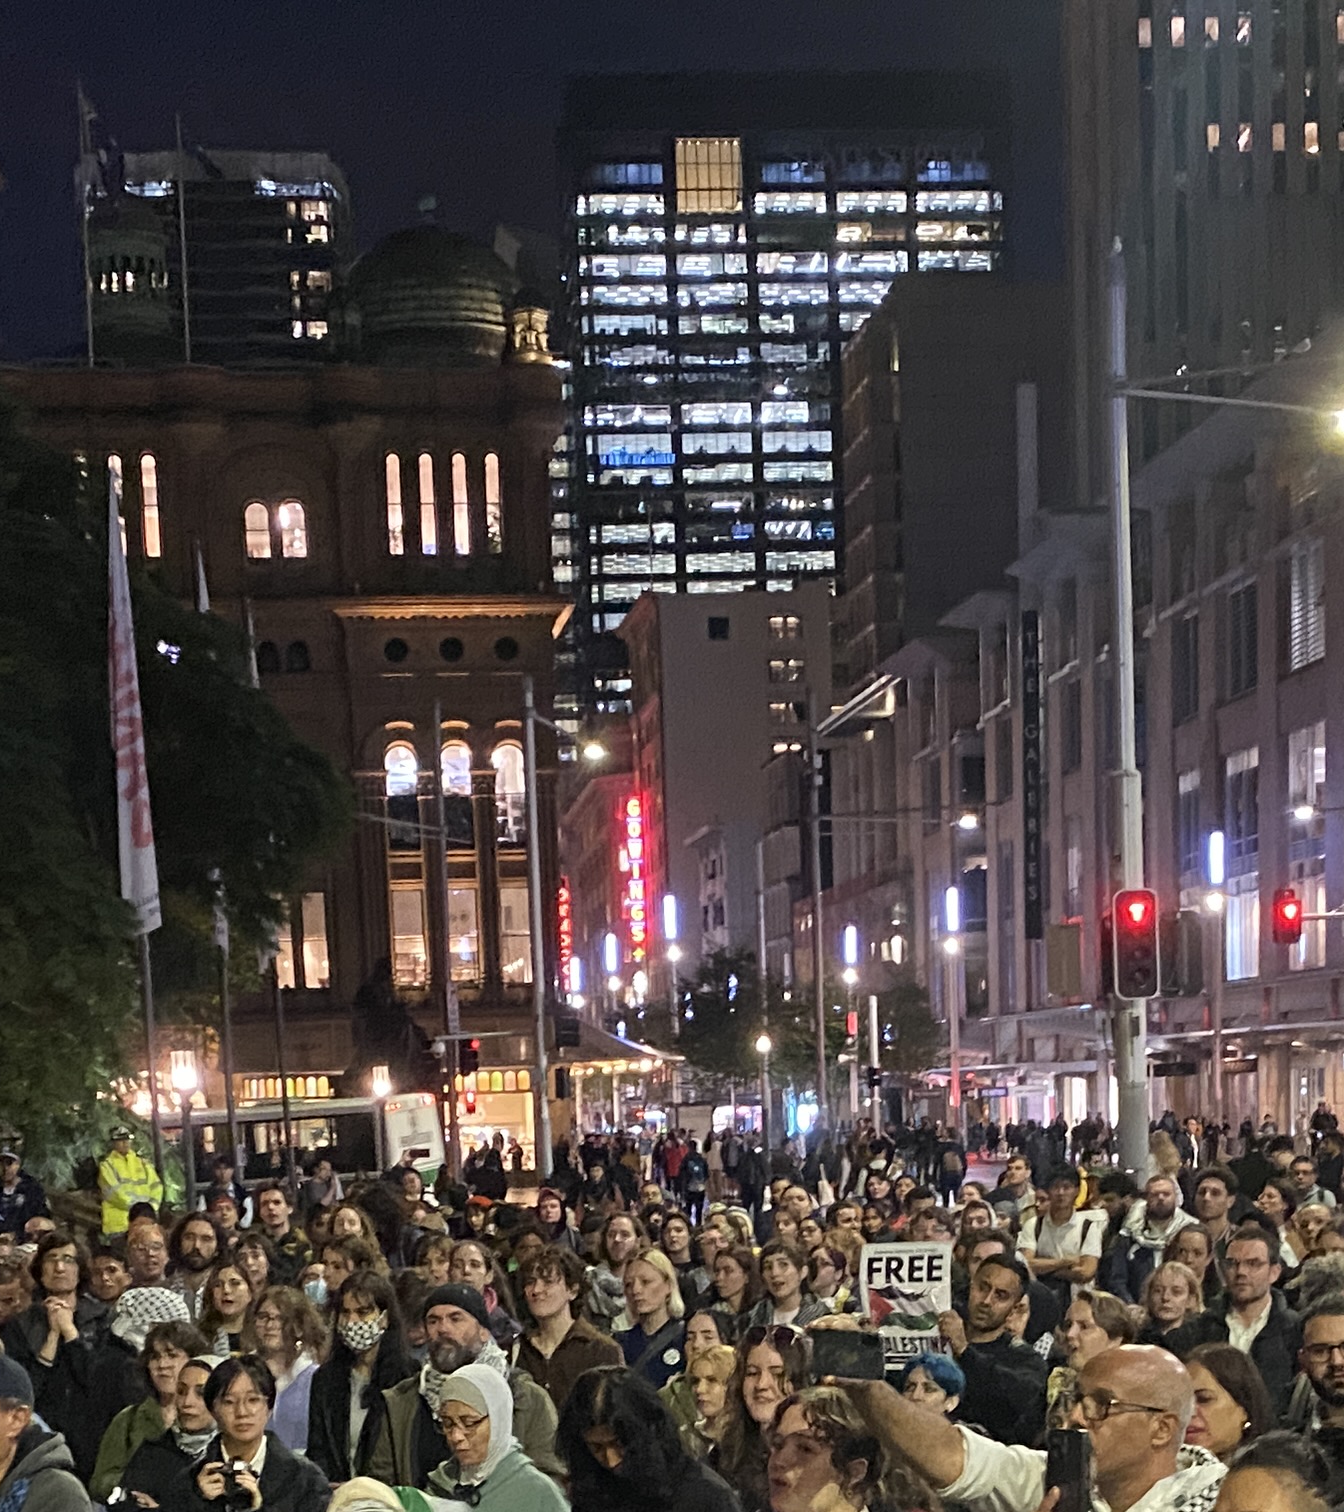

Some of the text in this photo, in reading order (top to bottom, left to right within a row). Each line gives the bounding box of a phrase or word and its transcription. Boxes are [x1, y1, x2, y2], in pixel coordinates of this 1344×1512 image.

[1024, 630, 1037, 694] THE
[625, 797, 646, 943] GOWINGS
[867, 1254, 944, 1285] FREE
